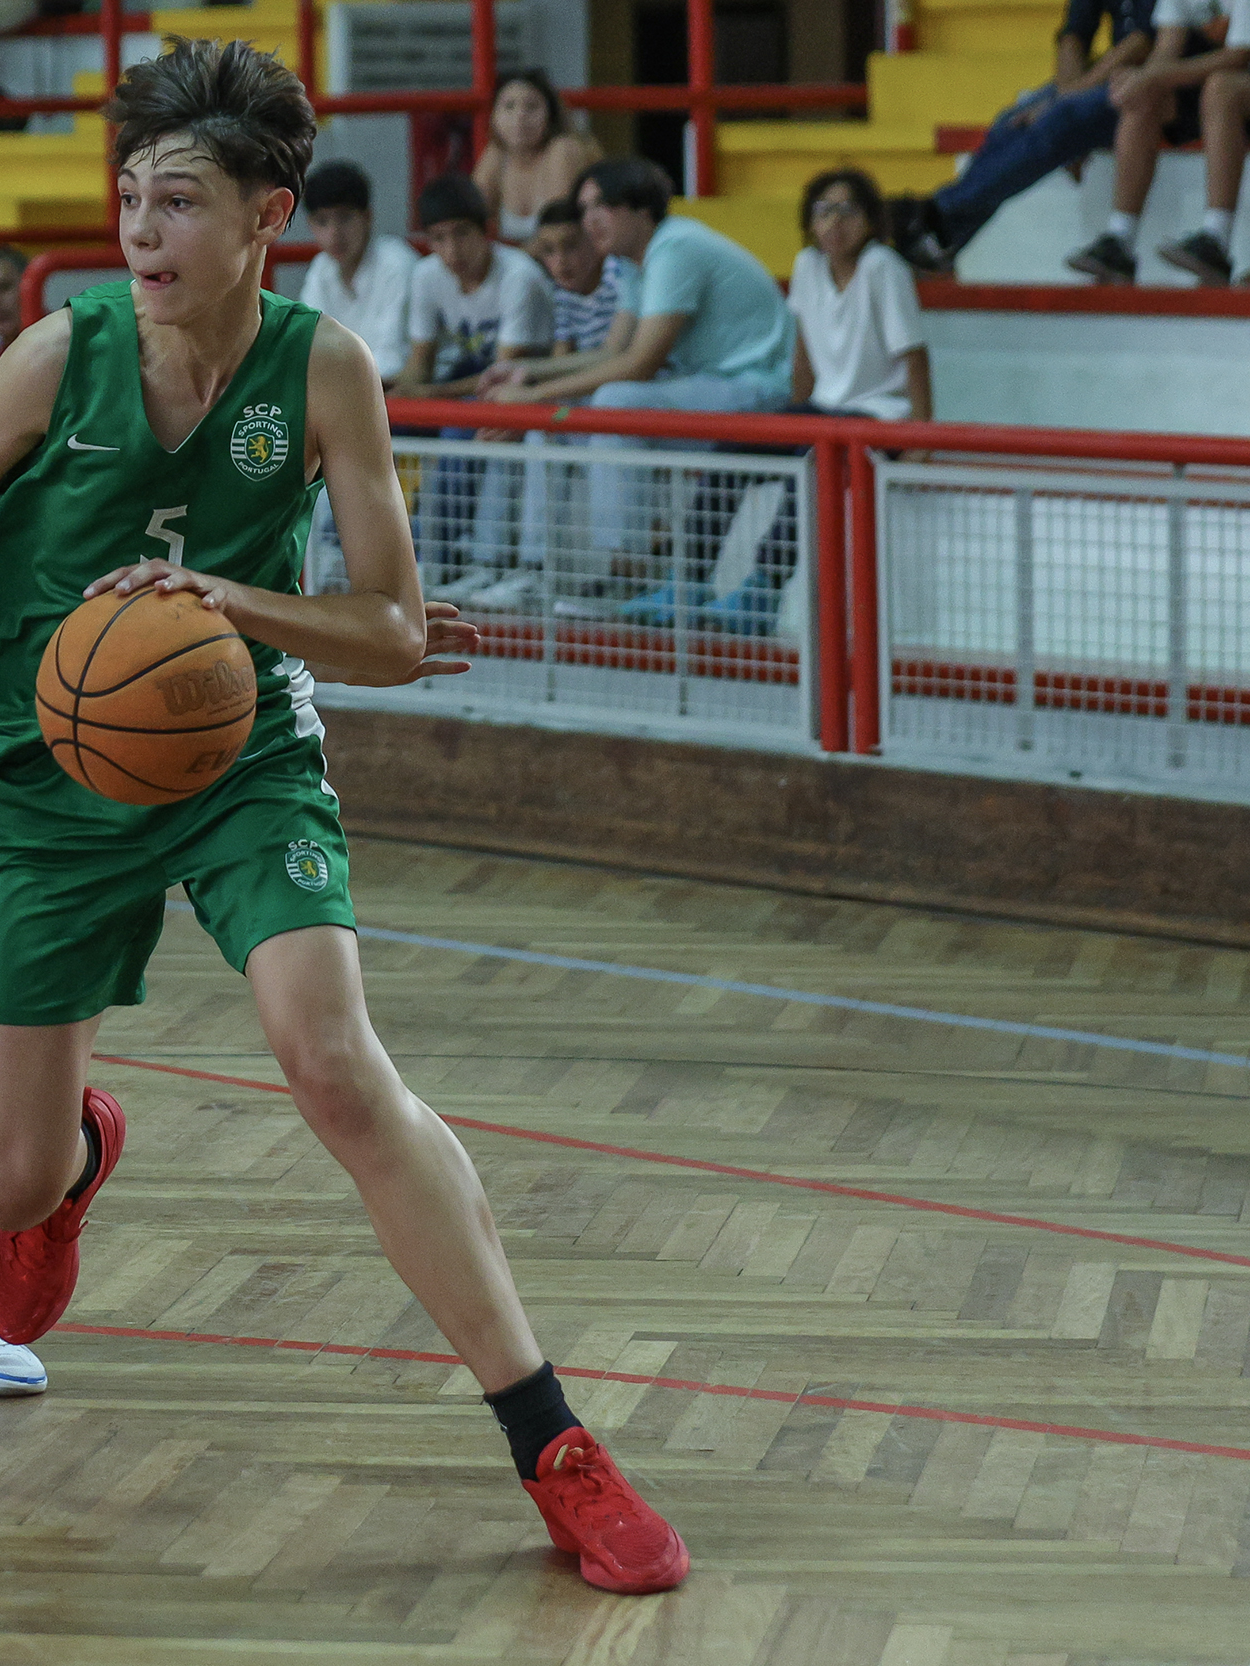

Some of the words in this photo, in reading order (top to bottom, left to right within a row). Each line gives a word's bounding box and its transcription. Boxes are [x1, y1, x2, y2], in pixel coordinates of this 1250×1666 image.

[243, 403, 282, 418] SCP
[238, 420, 284, 438] SPORTING
[238, 461, 279, 474] PORTUGAL
[139, 504, 188, 567] 5
[288, 838, 318, 851] SCP
